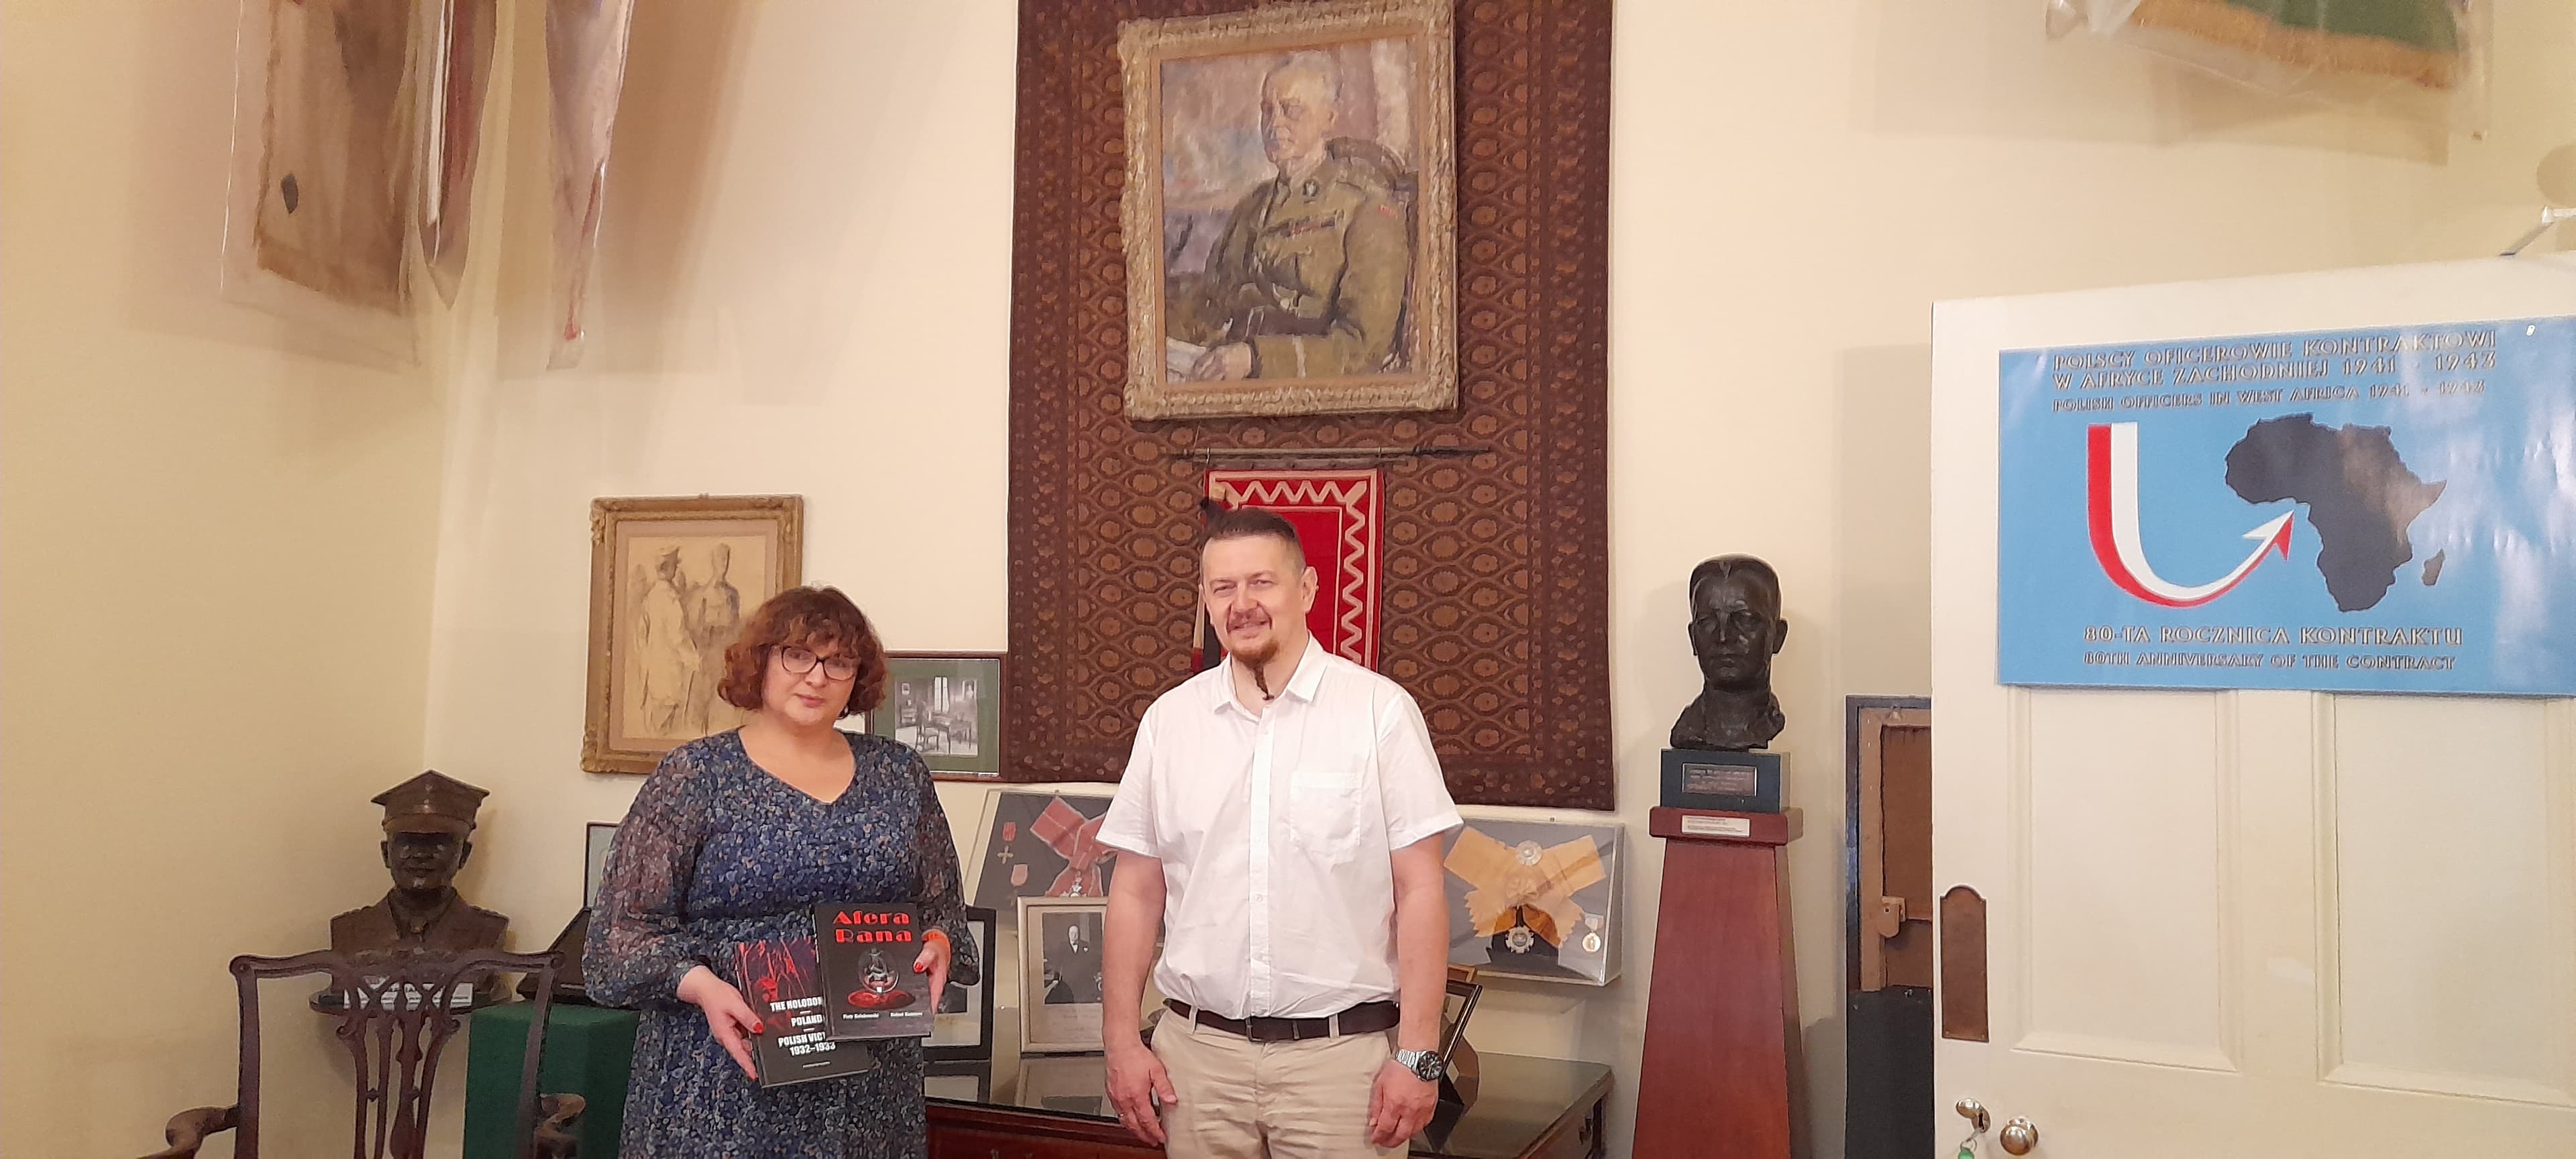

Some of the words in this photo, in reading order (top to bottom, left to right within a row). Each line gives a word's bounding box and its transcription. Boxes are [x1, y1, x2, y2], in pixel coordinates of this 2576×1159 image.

[2053, 350, 2136, 370] POLSCY
[2144, 341, 2292, 365] OFICEROWIE
[2304, 330, 2496, 356] KONTRAKTOWI
[2053, 372, 2072, 390] W
[2080, 370, 2164, 389] AFRYCE
[2173, 360, 2329, 386] ZACHODNIEJ
[2343, 355, 2396, 376] 1941
[2435, 350, 2496, 370] 1943
[2053, 396, 2114, 412] POLISH
[2121, 392, 2202, 408] OFFICERS
[2210, 391, 2230, 405] IN
[2237, 387, 2284, 404] WEST
[2290, 384, 2359, 401] AFRICA
[2084, 624, 2151, 643] 80-TA
[2159, 624, 2290, 644] ROCZNICA
[2300, 626, 2463, 645] KONTRAKTU
[2084, 651, 2130, 665] 80TH
[2136, 652, 2263, 668] ANNIVERSARY
[2270, 653, 2296, 668] OF
[2302, 654, 2339, 669] THE
[2347, 654, 2456, 670] CONTRACT
[833, 910, 909, 924] Afera
[836, 929, 912, 942] Rana
[770, 1001, 786, 1011] THE
[791, 1014, 822, 1027] POLAND
[778, 1034, 808, 1048] POLISH
